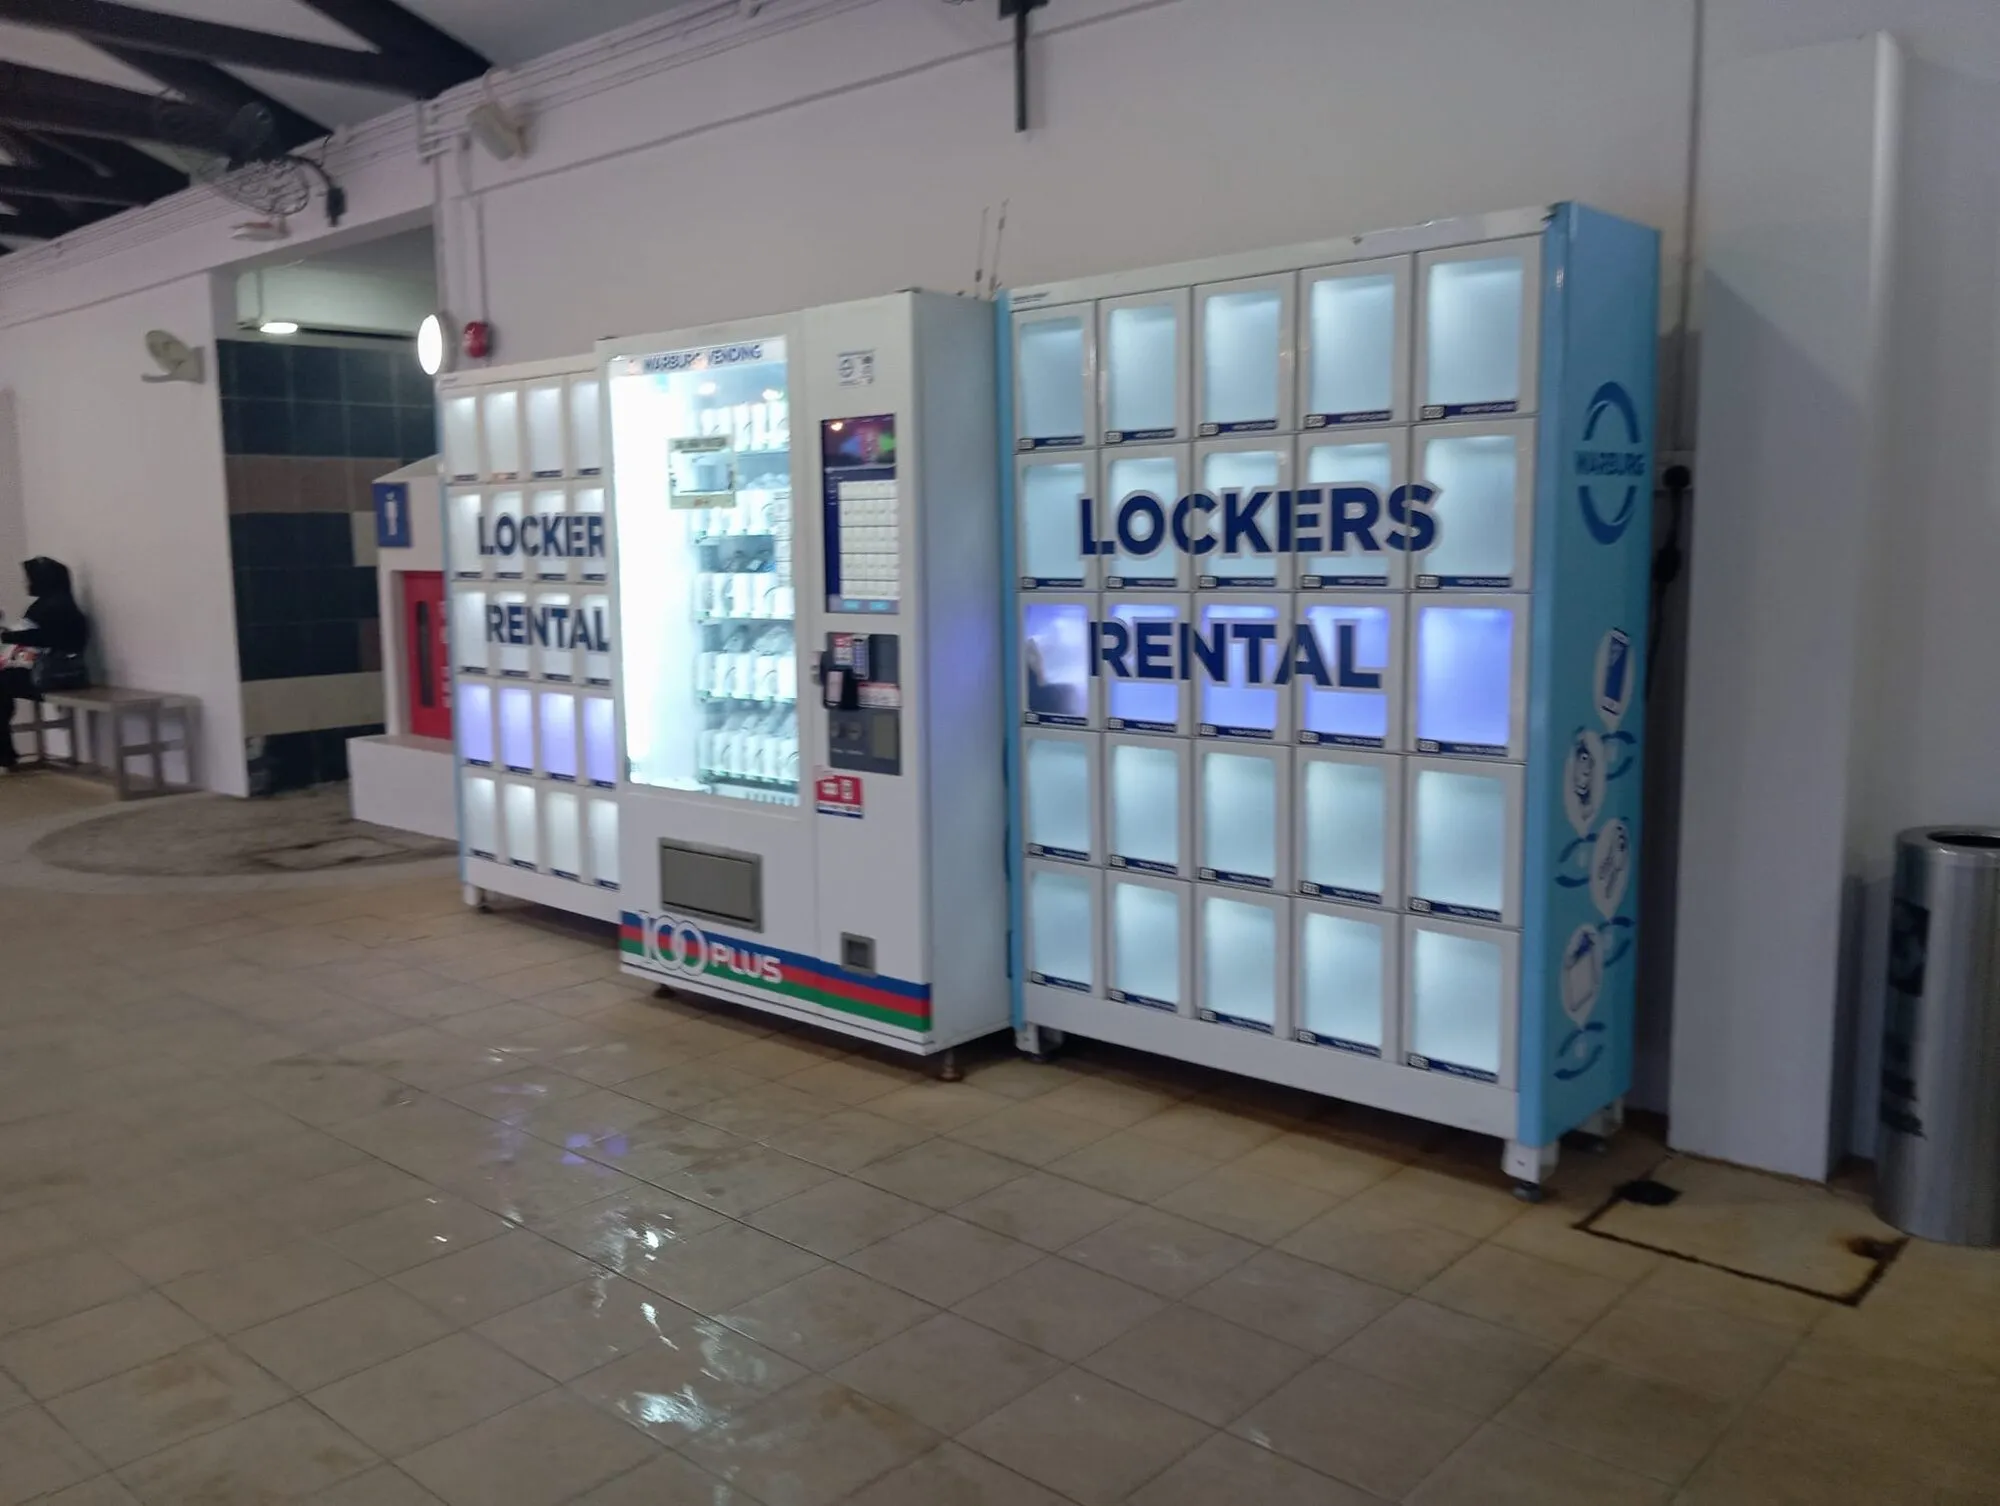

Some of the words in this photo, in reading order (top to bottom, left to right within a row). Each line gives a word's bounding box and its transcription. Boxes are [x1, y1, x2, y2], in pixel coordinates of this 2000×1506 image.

[1079, 484, 1436, 555] LOCKERS
[486, 604, 610, 652] RENTAL
[1089, 620, 1382, 689] RENTAL
[636, 910, 707, 976] 100
[708, 941, 783, 984] PLUS
